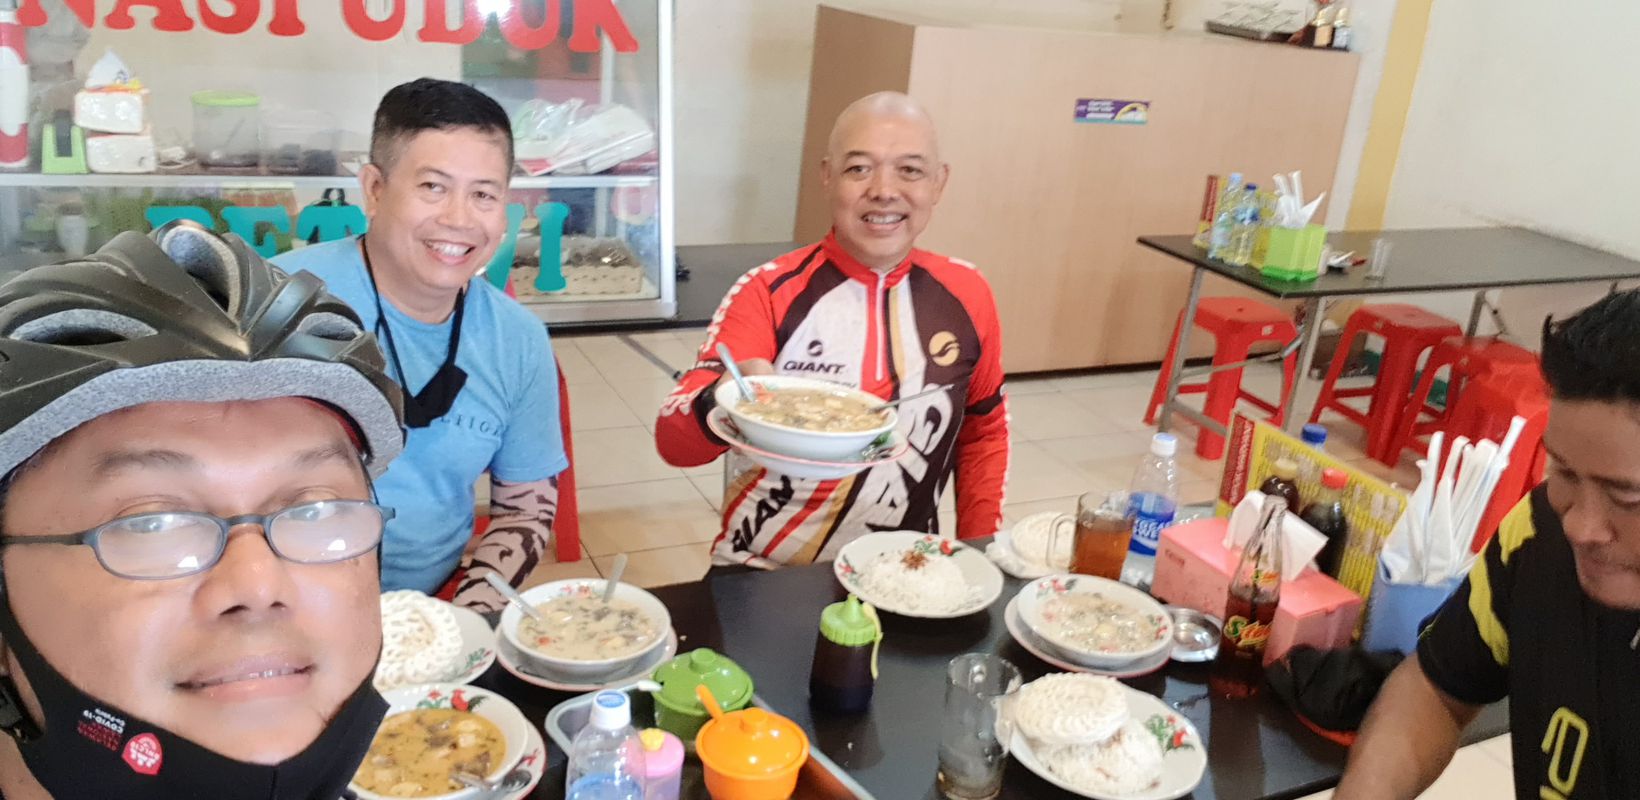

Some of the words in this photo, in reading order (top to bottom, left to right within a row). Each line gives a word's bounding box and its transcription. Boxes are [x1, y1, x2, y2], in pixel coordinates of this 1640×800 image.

[783, 360, 846, 374] GIANT
[732, 474, 803, 552] GIAN
[83, 710, 123, 733] COVID-19
